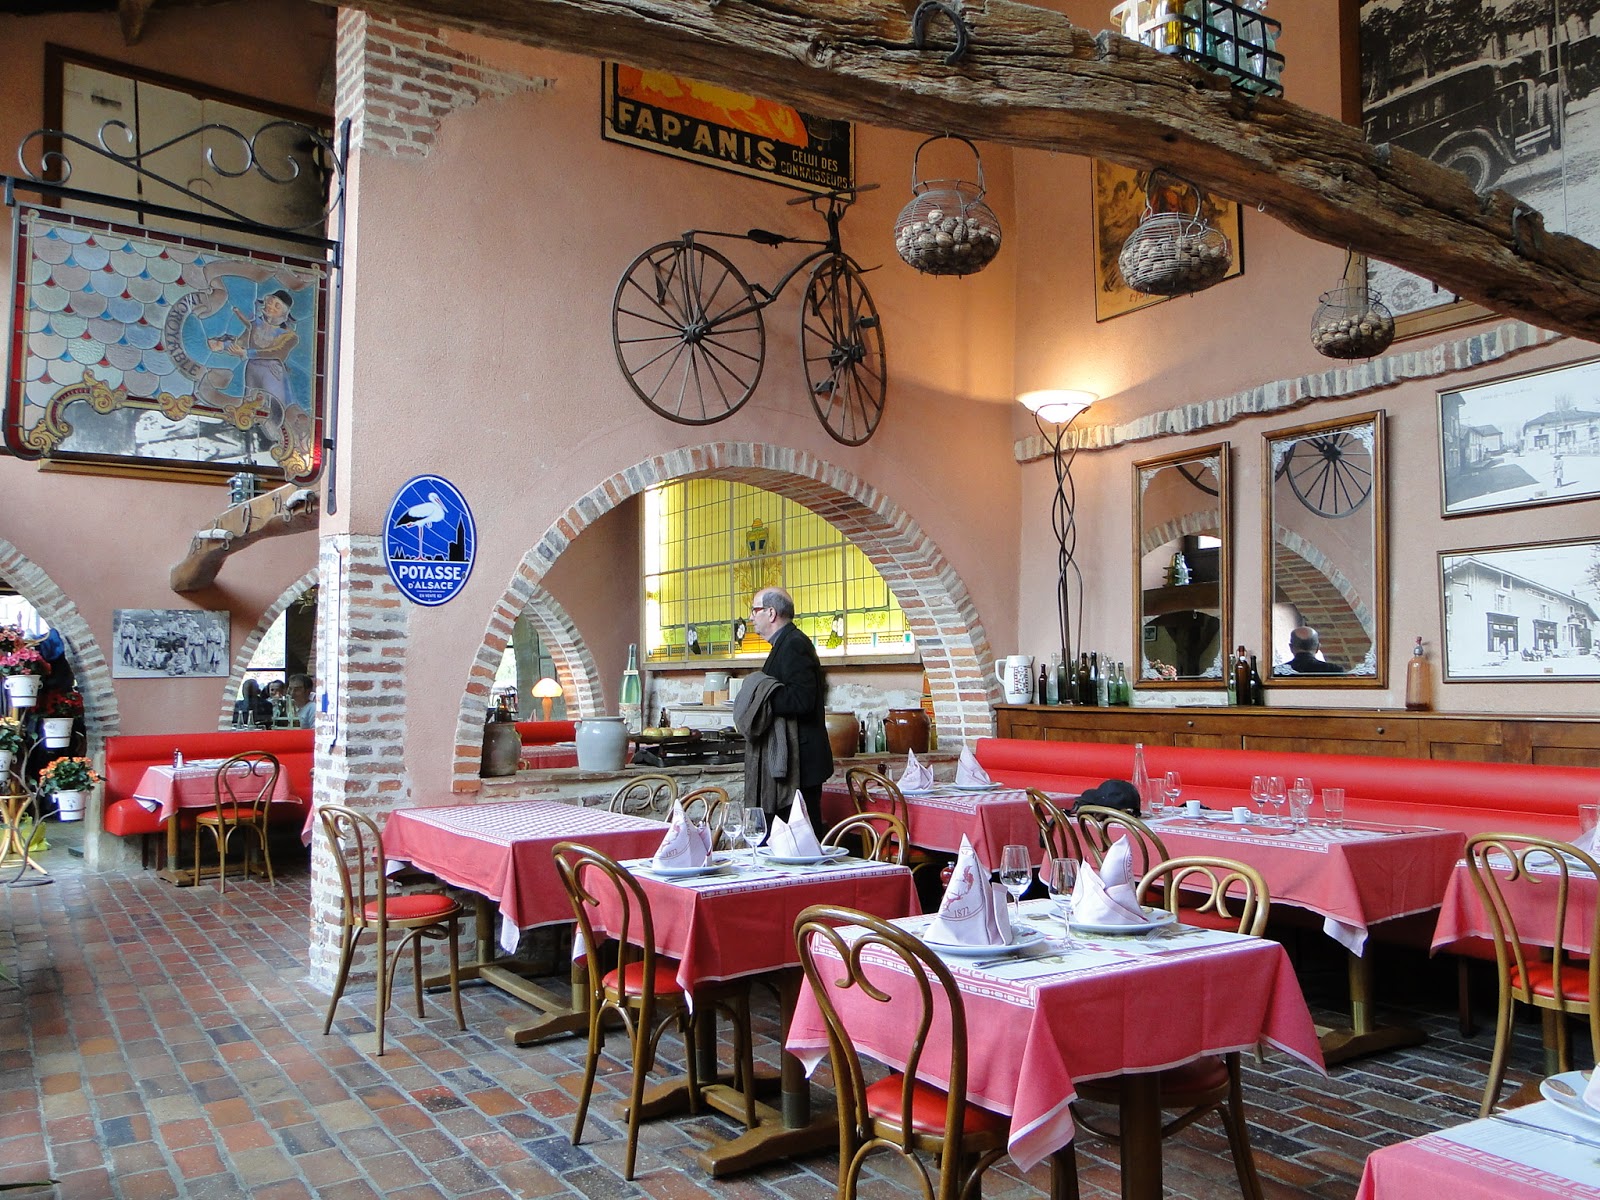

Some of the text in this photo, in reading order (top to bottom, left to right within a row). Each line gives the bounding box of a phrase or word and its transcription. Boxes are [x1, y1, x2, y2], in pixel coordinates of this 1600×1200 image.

[618, 102, 777, 170] FAP'ANIS
[792, 149, 818, 167] CELUI
[821, 155, 838, 173] DES
[780, 160, 848, 190] CONNAISSEURS
[399, 565, 461, 580] POTASSE
